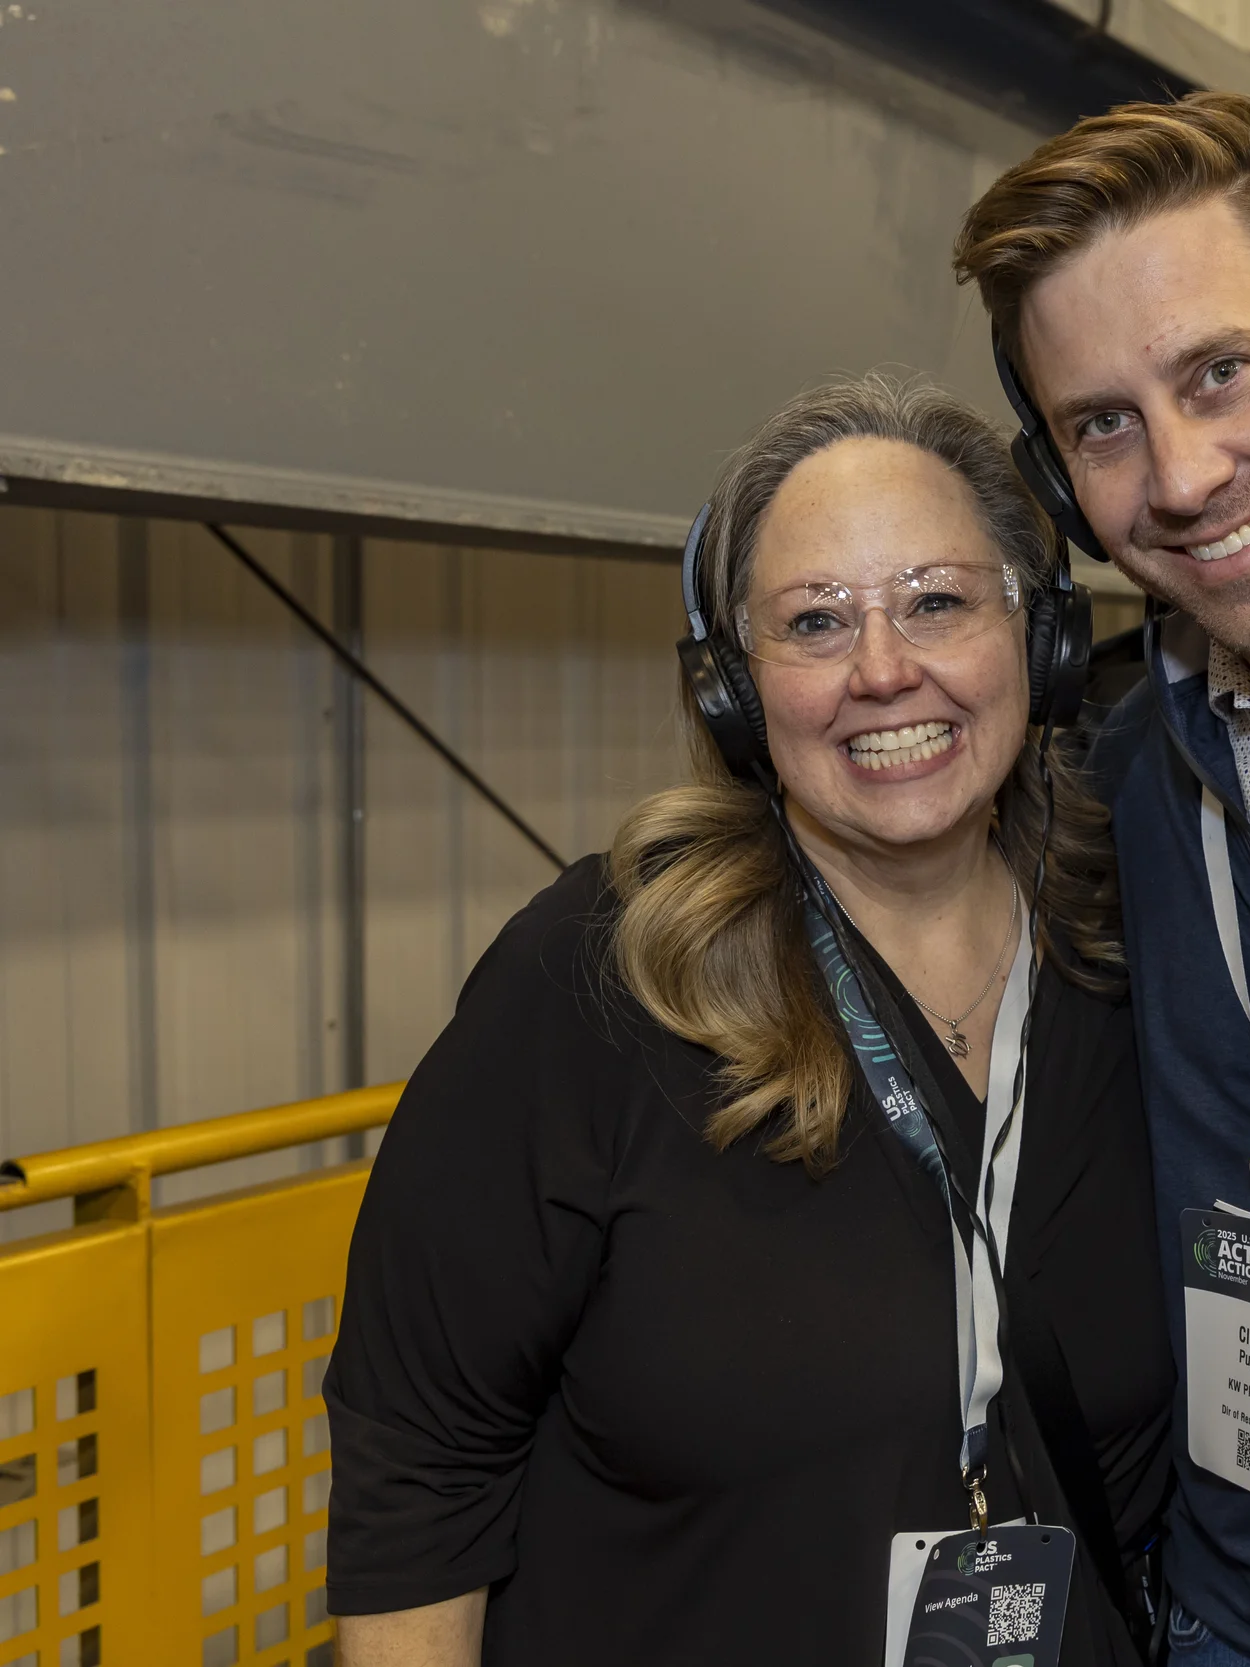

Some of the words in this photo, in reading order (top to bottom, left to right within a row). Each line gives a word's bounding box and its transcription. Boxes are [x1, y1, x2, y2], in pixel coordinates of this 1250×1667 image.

[888, 1076, 910, 1115] PLASTICS
[902, 1090, 918, 1112] PACT
[1217, 1229, 1237, 1241] 2025
[1218, 1271, 1249, 1286] November
[1228, 1377, 1241, 1393] KW
[1221, 1404, 1231, 1417] Dir
[1233, 1410, 1239, 1420] of
[975, 1553, 1013, 1565] PLASTICS
[974, 1562, 995, 1573] PACT
[925, 1599, 944, 1614] View
[945, 1592, 979, 1610] Agenda
